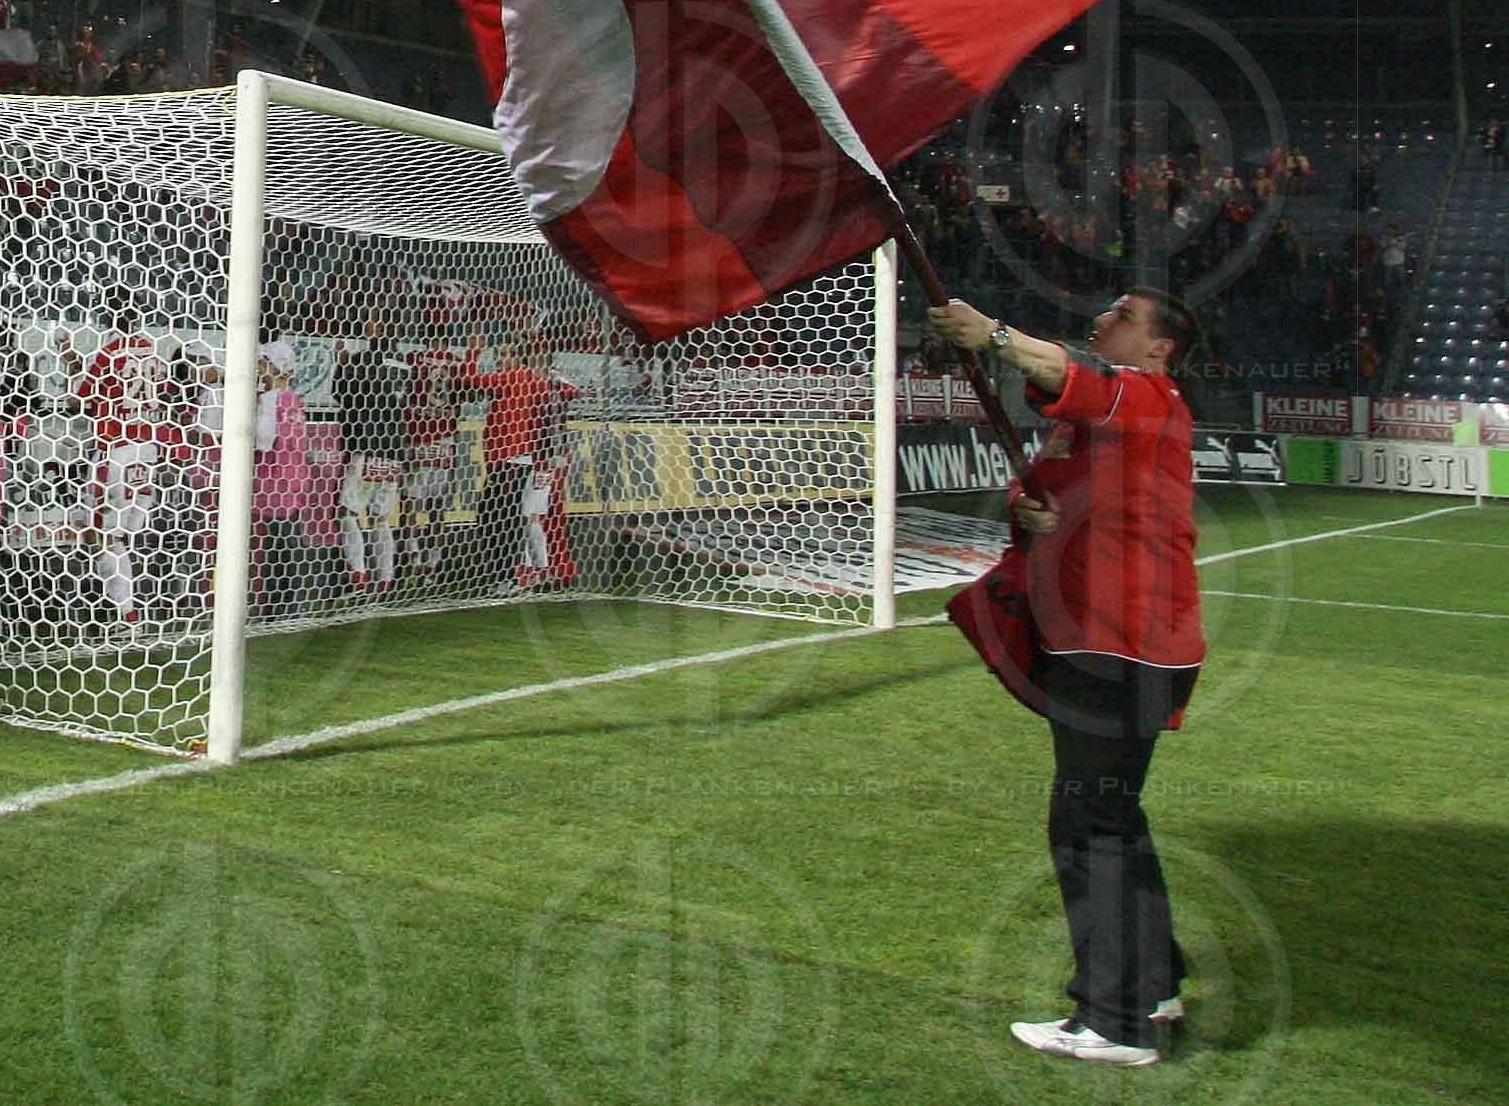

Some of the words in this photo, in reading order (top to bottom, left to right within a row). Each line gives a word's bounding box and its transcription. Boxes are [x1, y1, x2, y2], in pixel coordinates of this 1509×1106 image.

[1266, 396, 1349, 419] KLEINE
[1374, 401, 1458, 424] KLEINE
[1347, 448, 1478, 491] JÖBSTL
